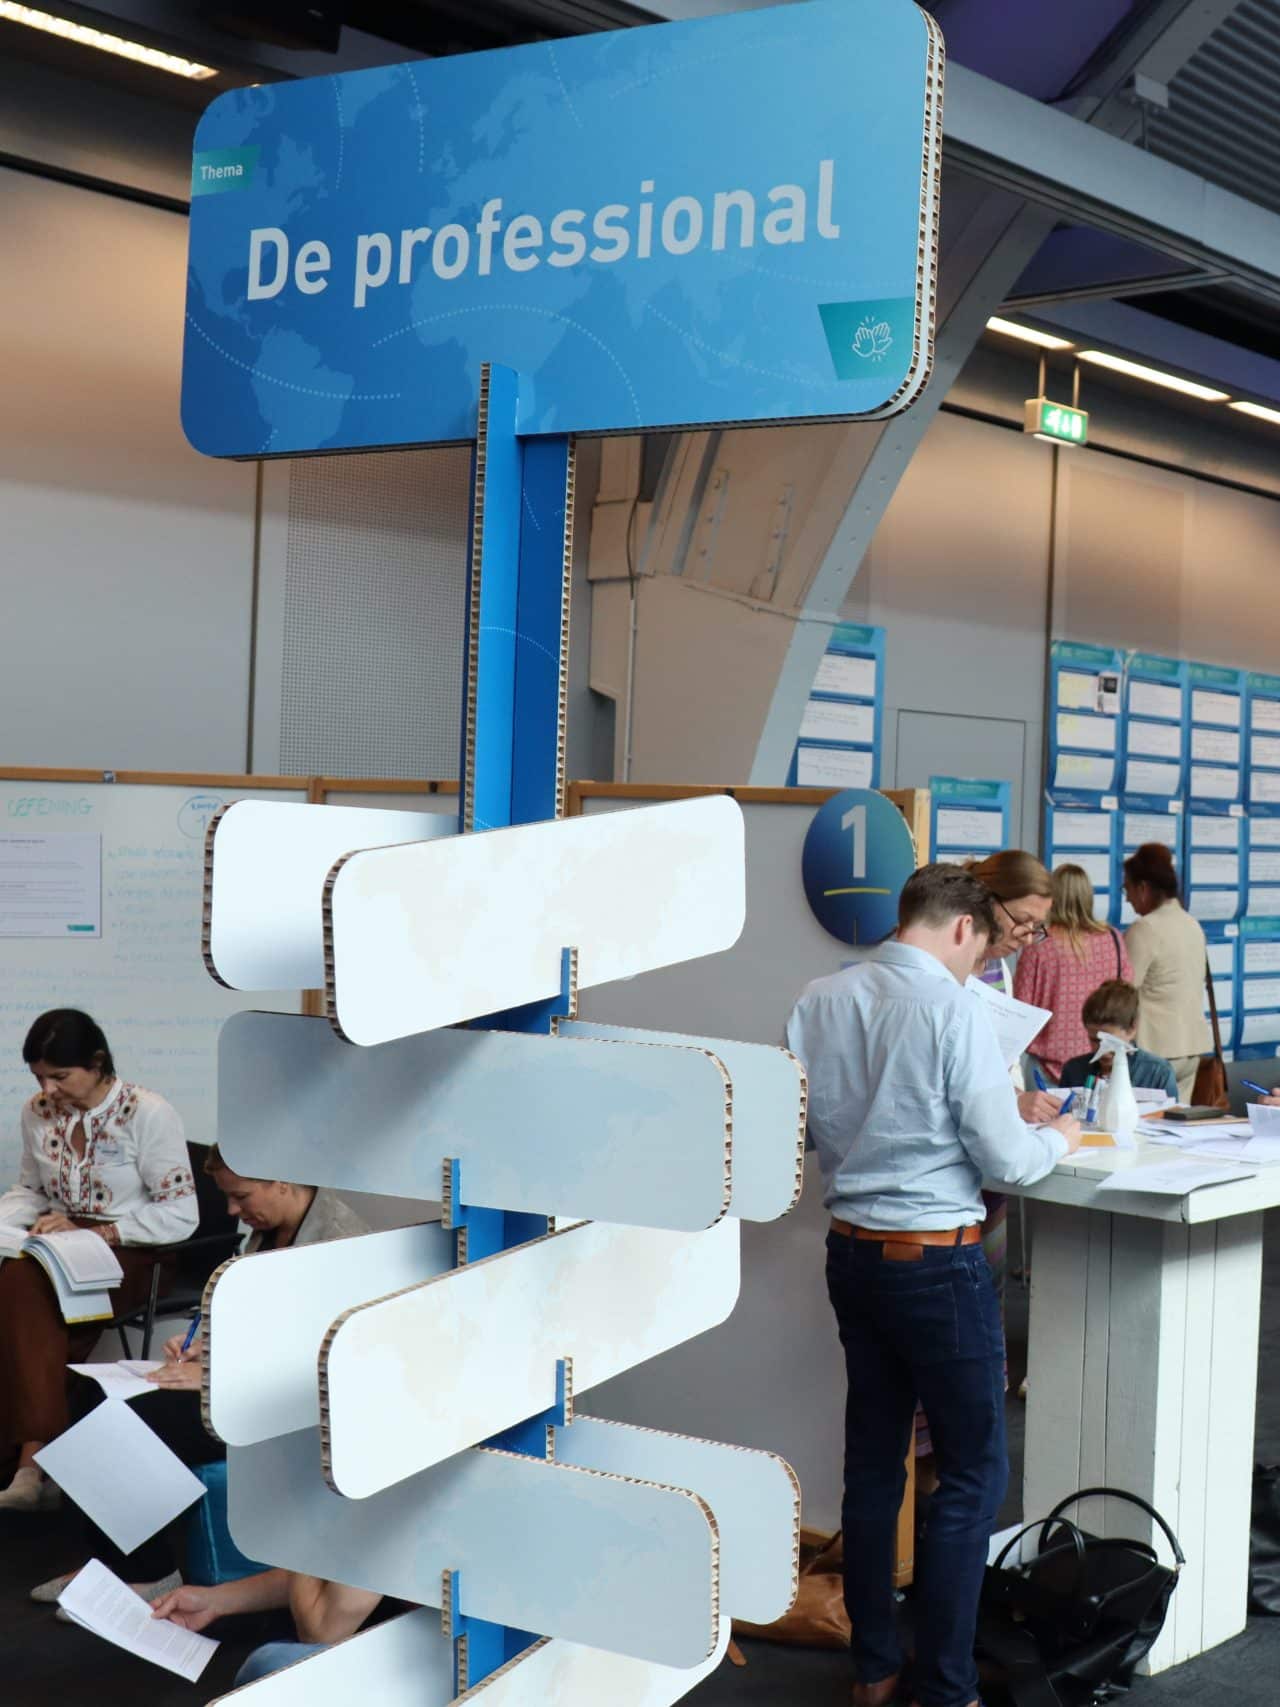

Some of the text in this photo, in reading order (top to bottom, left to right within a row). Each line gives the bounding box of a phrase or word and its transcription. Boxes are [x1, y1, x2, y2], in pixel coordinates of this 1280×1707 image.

[201, 164, 243, 180] Thema
[248, 159, 840, 307] De professional
[842, 805, 866, 878] 1
